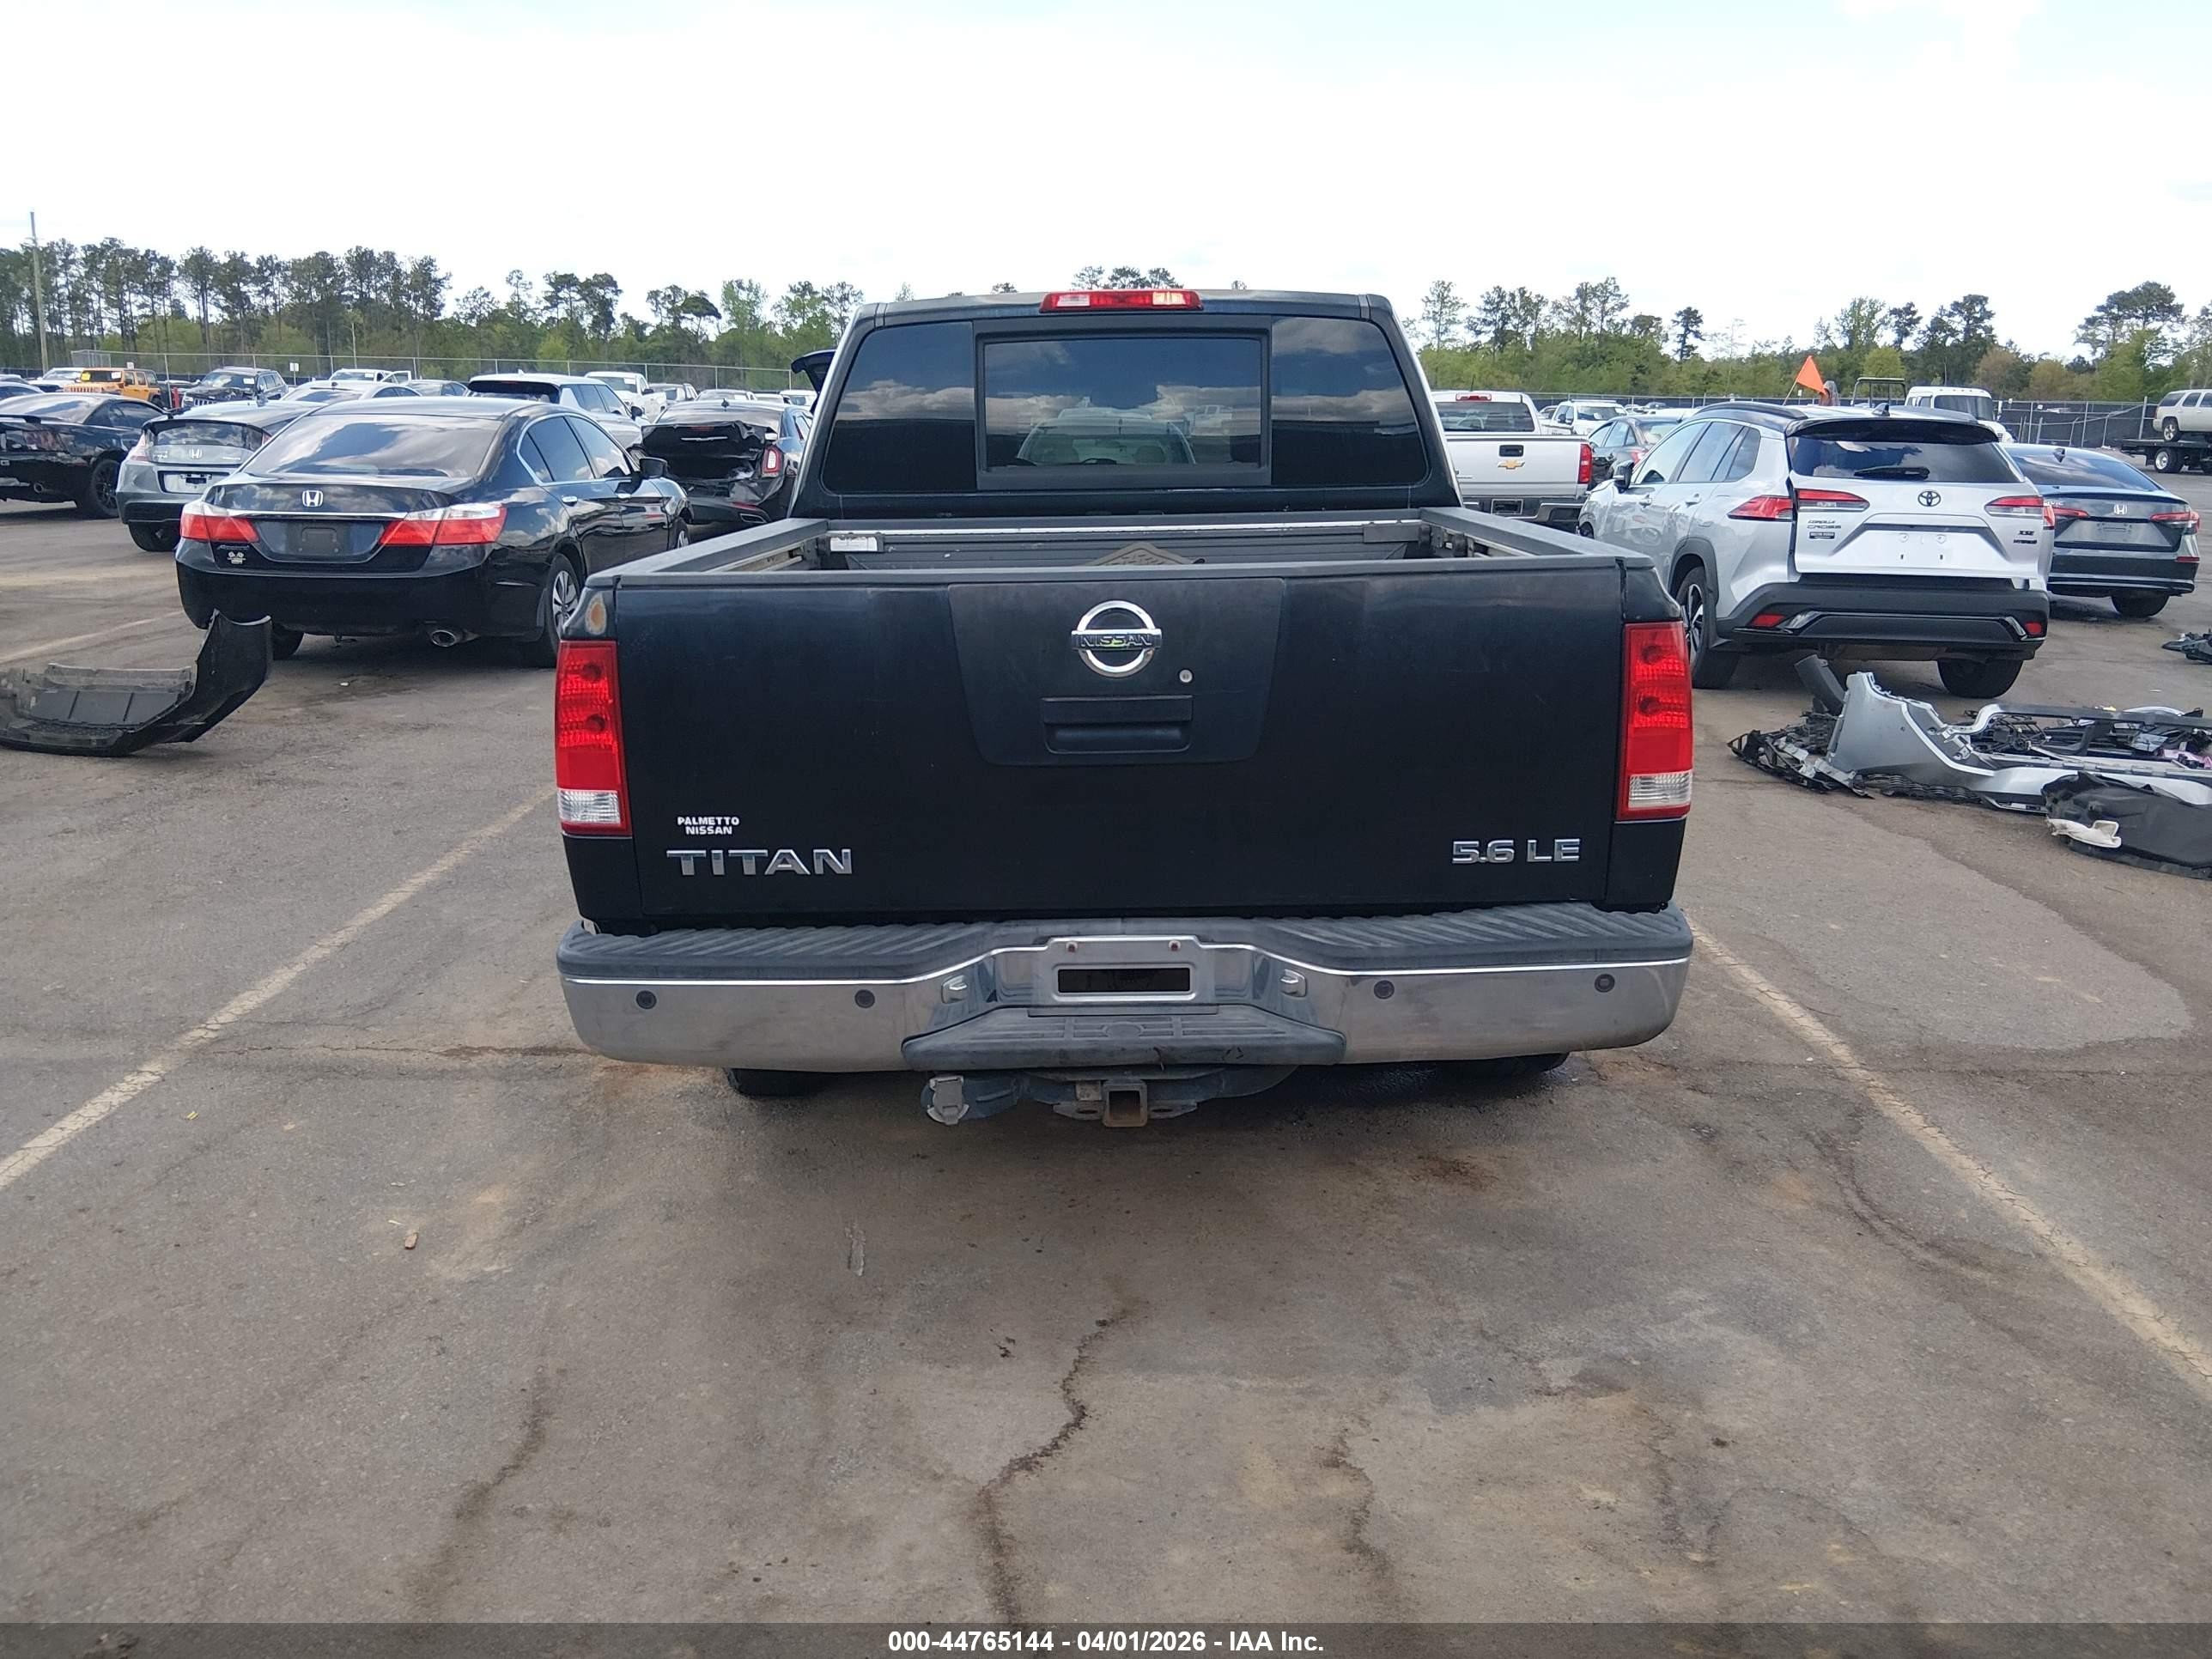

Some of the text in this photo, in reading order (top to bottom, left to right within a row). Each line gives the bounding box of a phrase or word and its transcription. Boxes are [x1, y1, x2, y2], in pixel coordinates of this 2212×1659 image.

[1080, 634, 1152, 647] NISSAN
[677, 817, 740, 825] PALMETTO
[685, 826, 732, 835] NISSAN
[1452, 838, 1581, 864] 5.6 LE
[666, 848, 853, 876] TITAN
